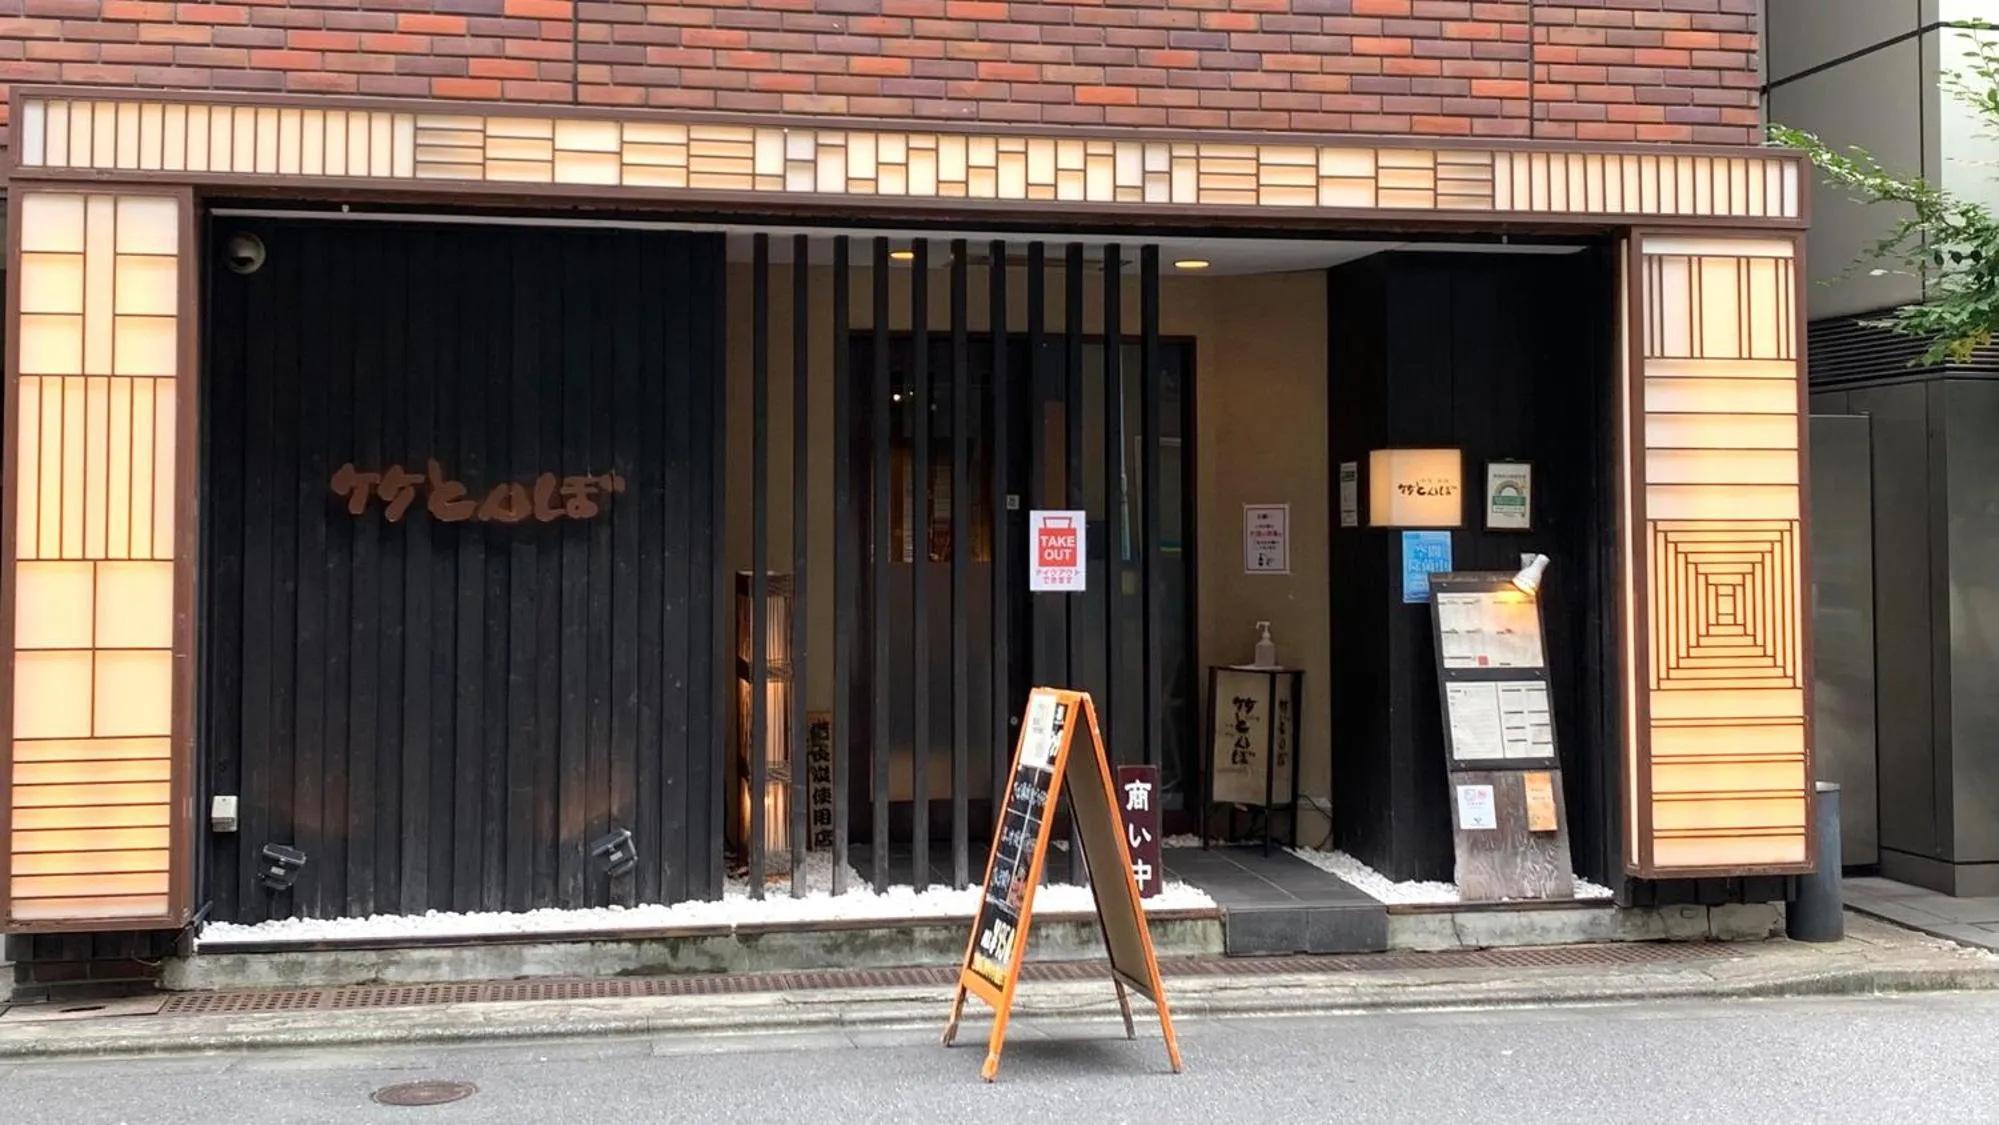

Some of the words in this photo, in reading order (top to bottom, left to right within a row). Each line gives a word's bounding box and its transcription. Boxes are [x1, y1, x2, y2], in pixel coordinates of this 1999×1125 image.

[1041, 535, 1076, 547] TAKE
[1044, 548, 1072, 561] OUT
[1124, 779, 1152, 891] 商い中
